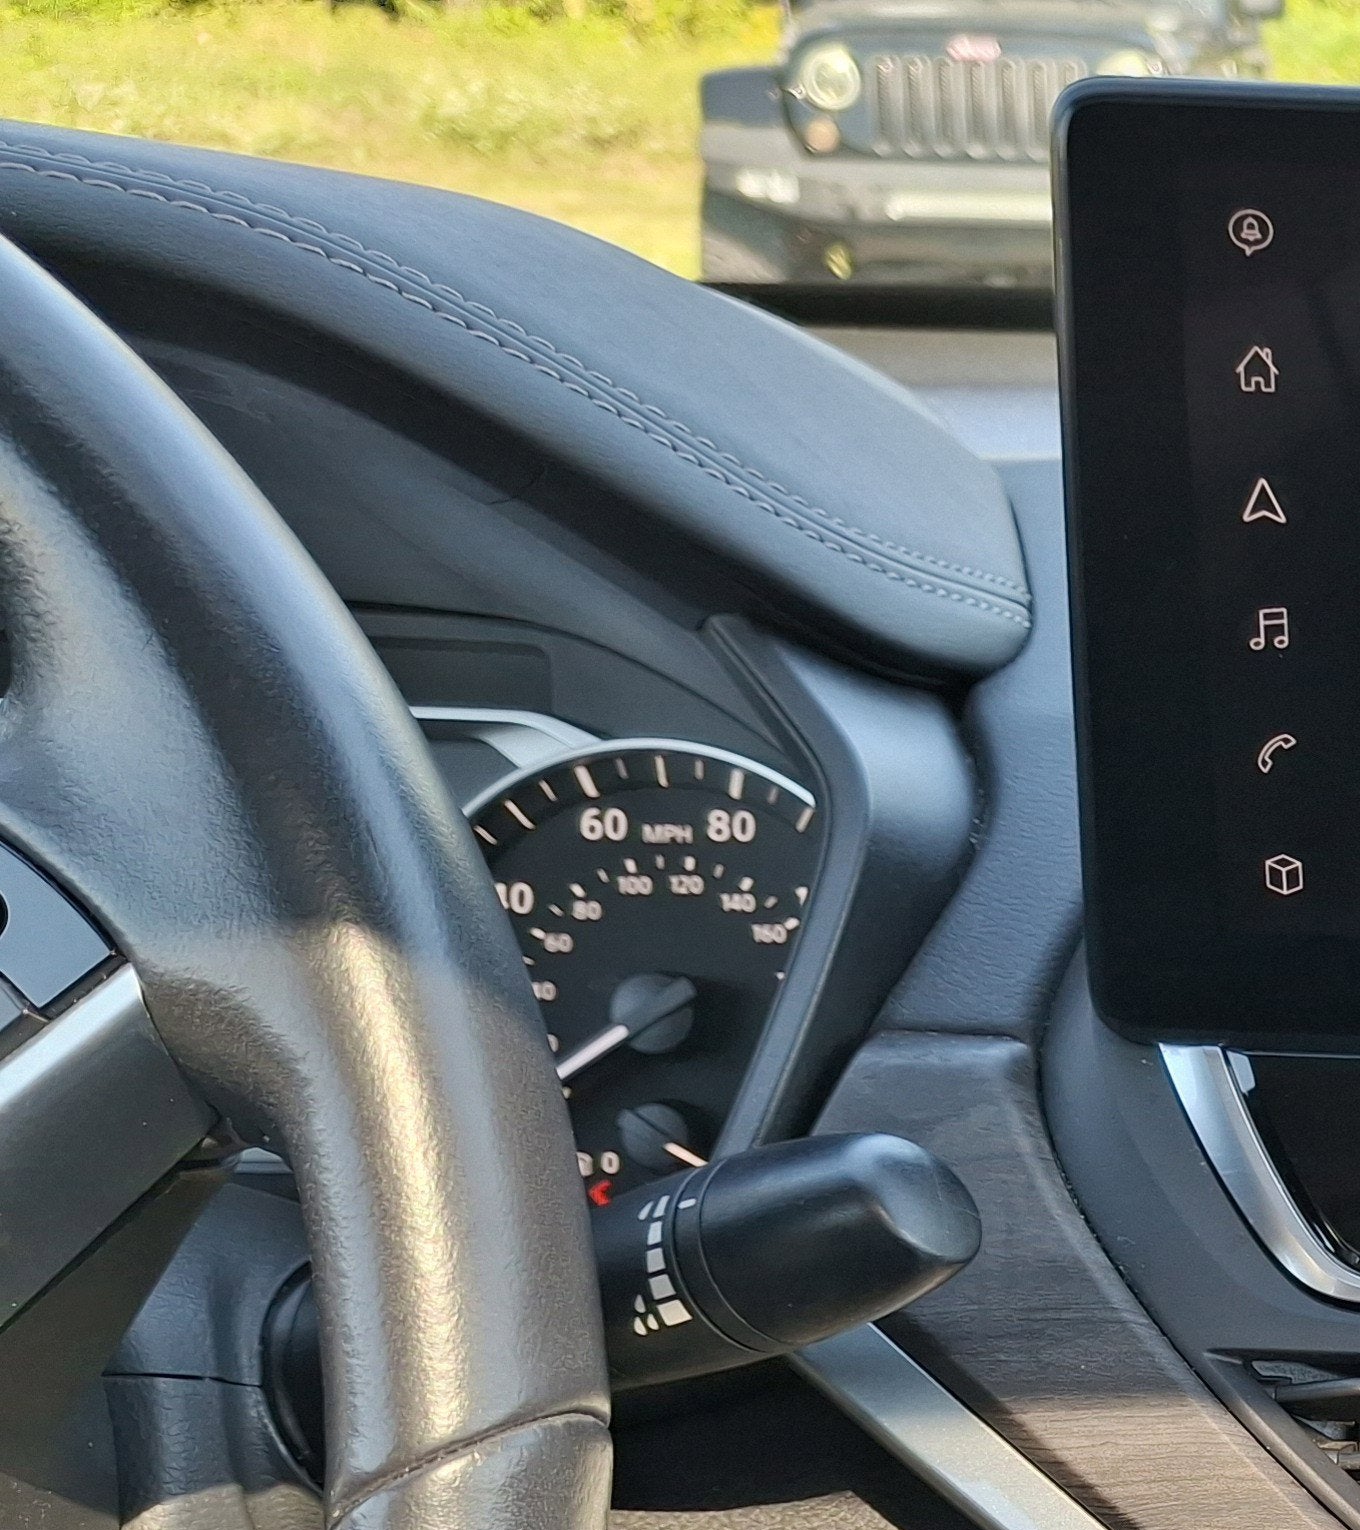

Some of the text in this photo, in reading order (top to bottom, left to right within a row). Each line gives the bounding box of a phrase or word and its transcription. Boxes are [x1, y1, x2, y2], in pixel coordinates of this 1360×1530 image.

[580, 807, 757, 844] 60 MPH 80
[668, 874, 705, 895] 120
